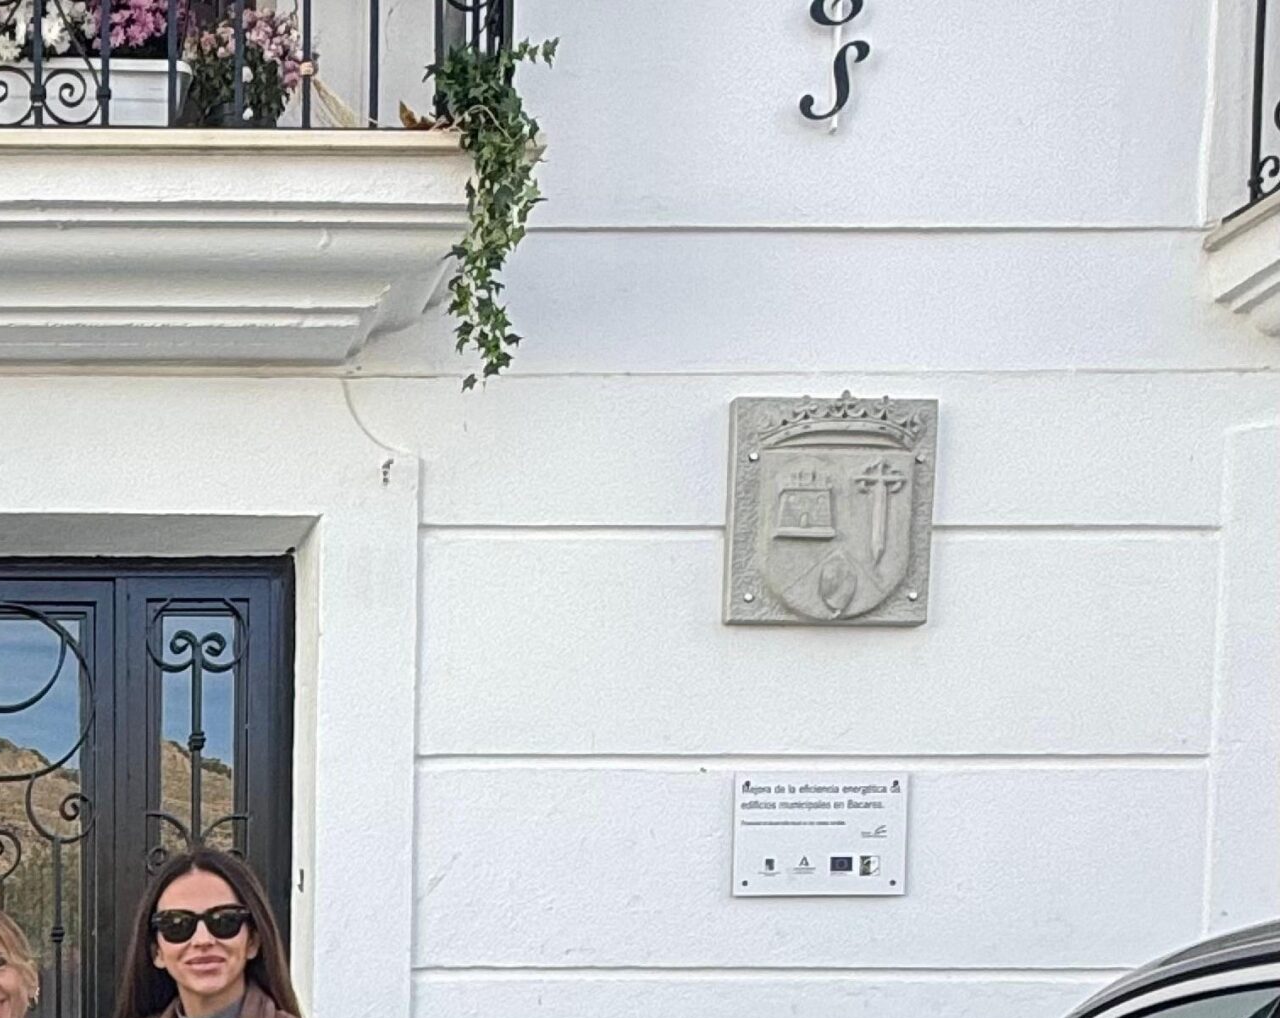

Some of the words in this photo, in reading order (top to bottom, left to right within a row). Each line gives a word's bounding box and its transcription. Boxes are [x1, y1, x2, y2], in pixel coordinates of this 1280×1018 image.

[774, 784, 785, 793] de
[788, 784, 796, 793] la
[799, 784, 839, 794] eficiencia
[741, 800, 777, 809] edificios
[779, 800, 831, 811] municipales
